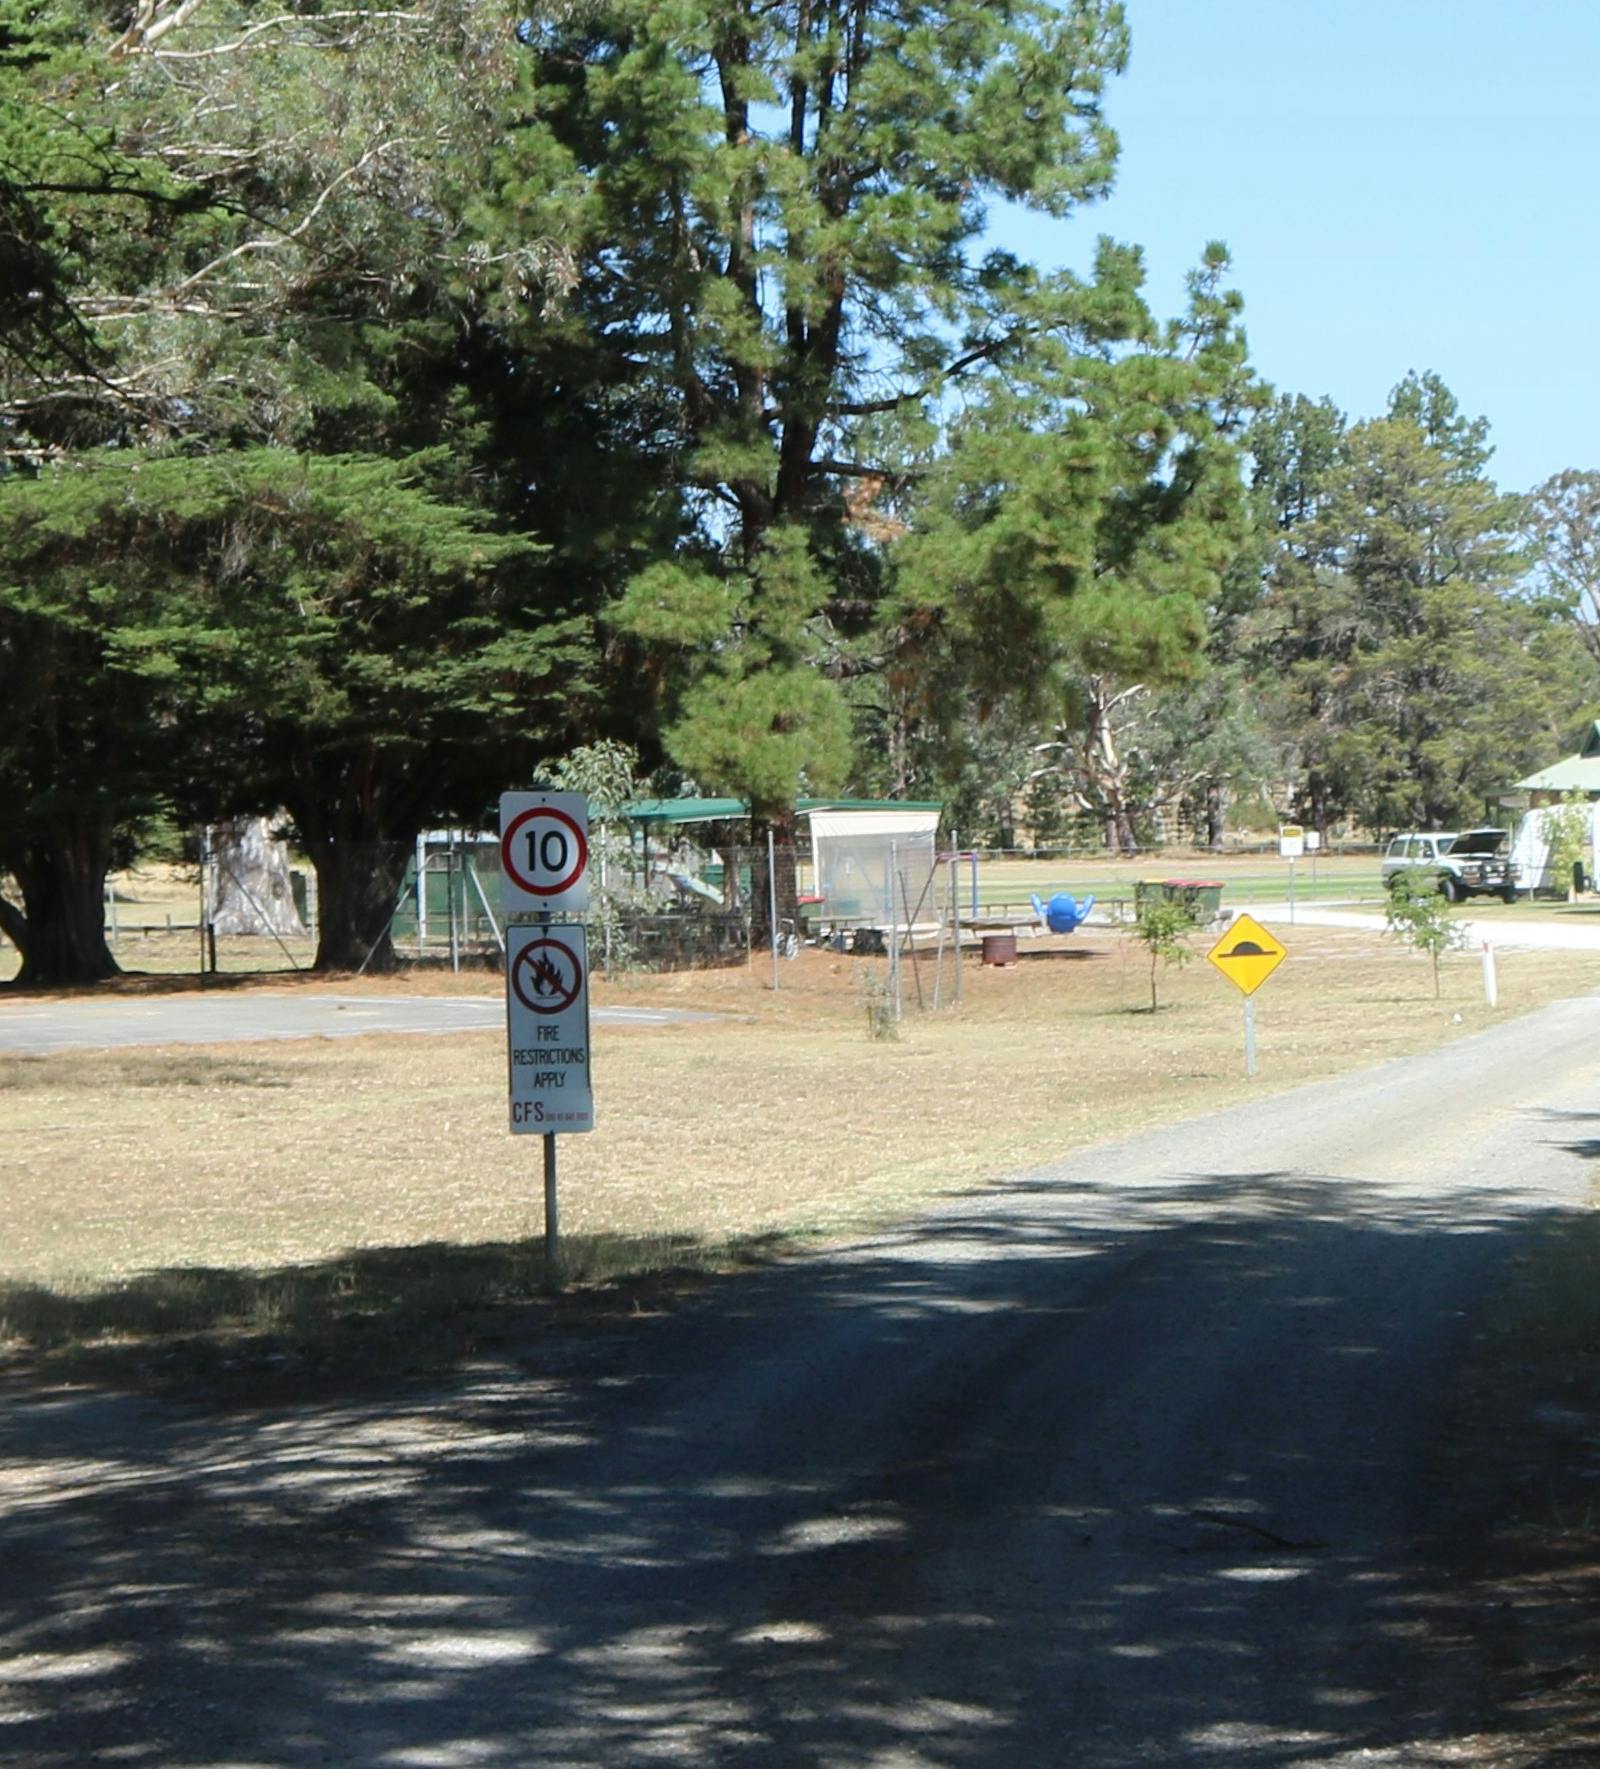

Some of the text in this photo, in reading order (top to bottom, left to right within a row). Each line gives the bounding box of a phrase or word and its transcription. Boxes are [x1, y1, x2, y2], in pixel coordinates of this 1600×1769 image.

[525, 830, 568, 872] 10
[536, 1025, 561, 1042] FIRE
[513, 1048, 586, 1065] RESTRICTIONS
[533, 1071, 566, 1089] APPLY
[512, 1101, 545, 1123] CFS
